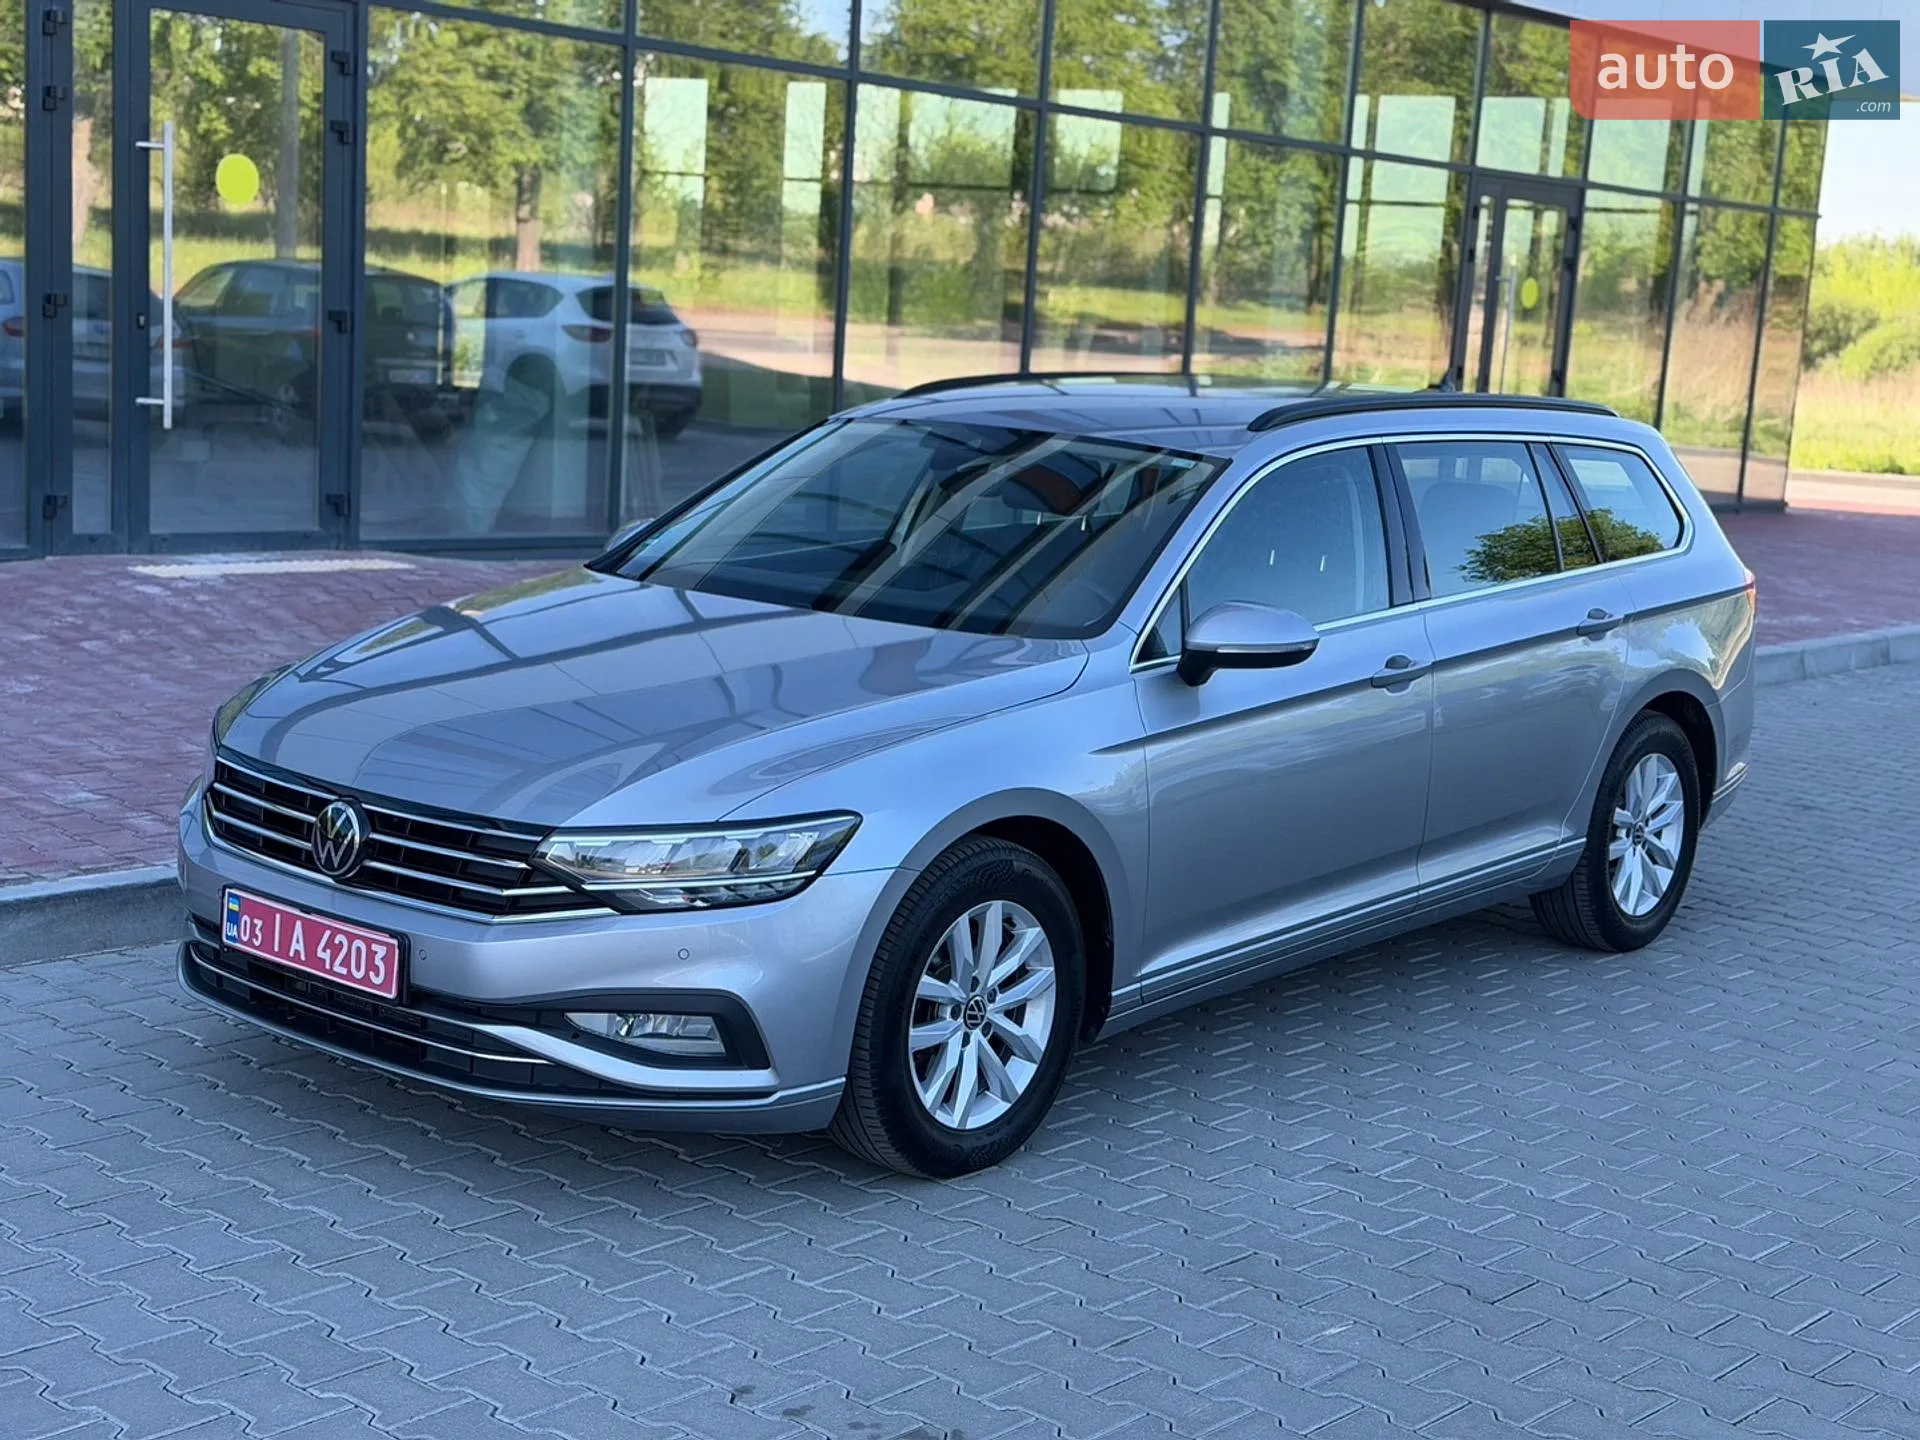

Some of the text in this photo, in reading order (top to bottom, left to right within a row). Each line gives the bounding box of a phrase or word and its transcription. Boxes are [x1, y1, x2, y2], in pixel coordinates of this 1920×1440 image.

[226, 921, 239, 938] UA
[241, 913, 388, 985] 03 IA 4203
